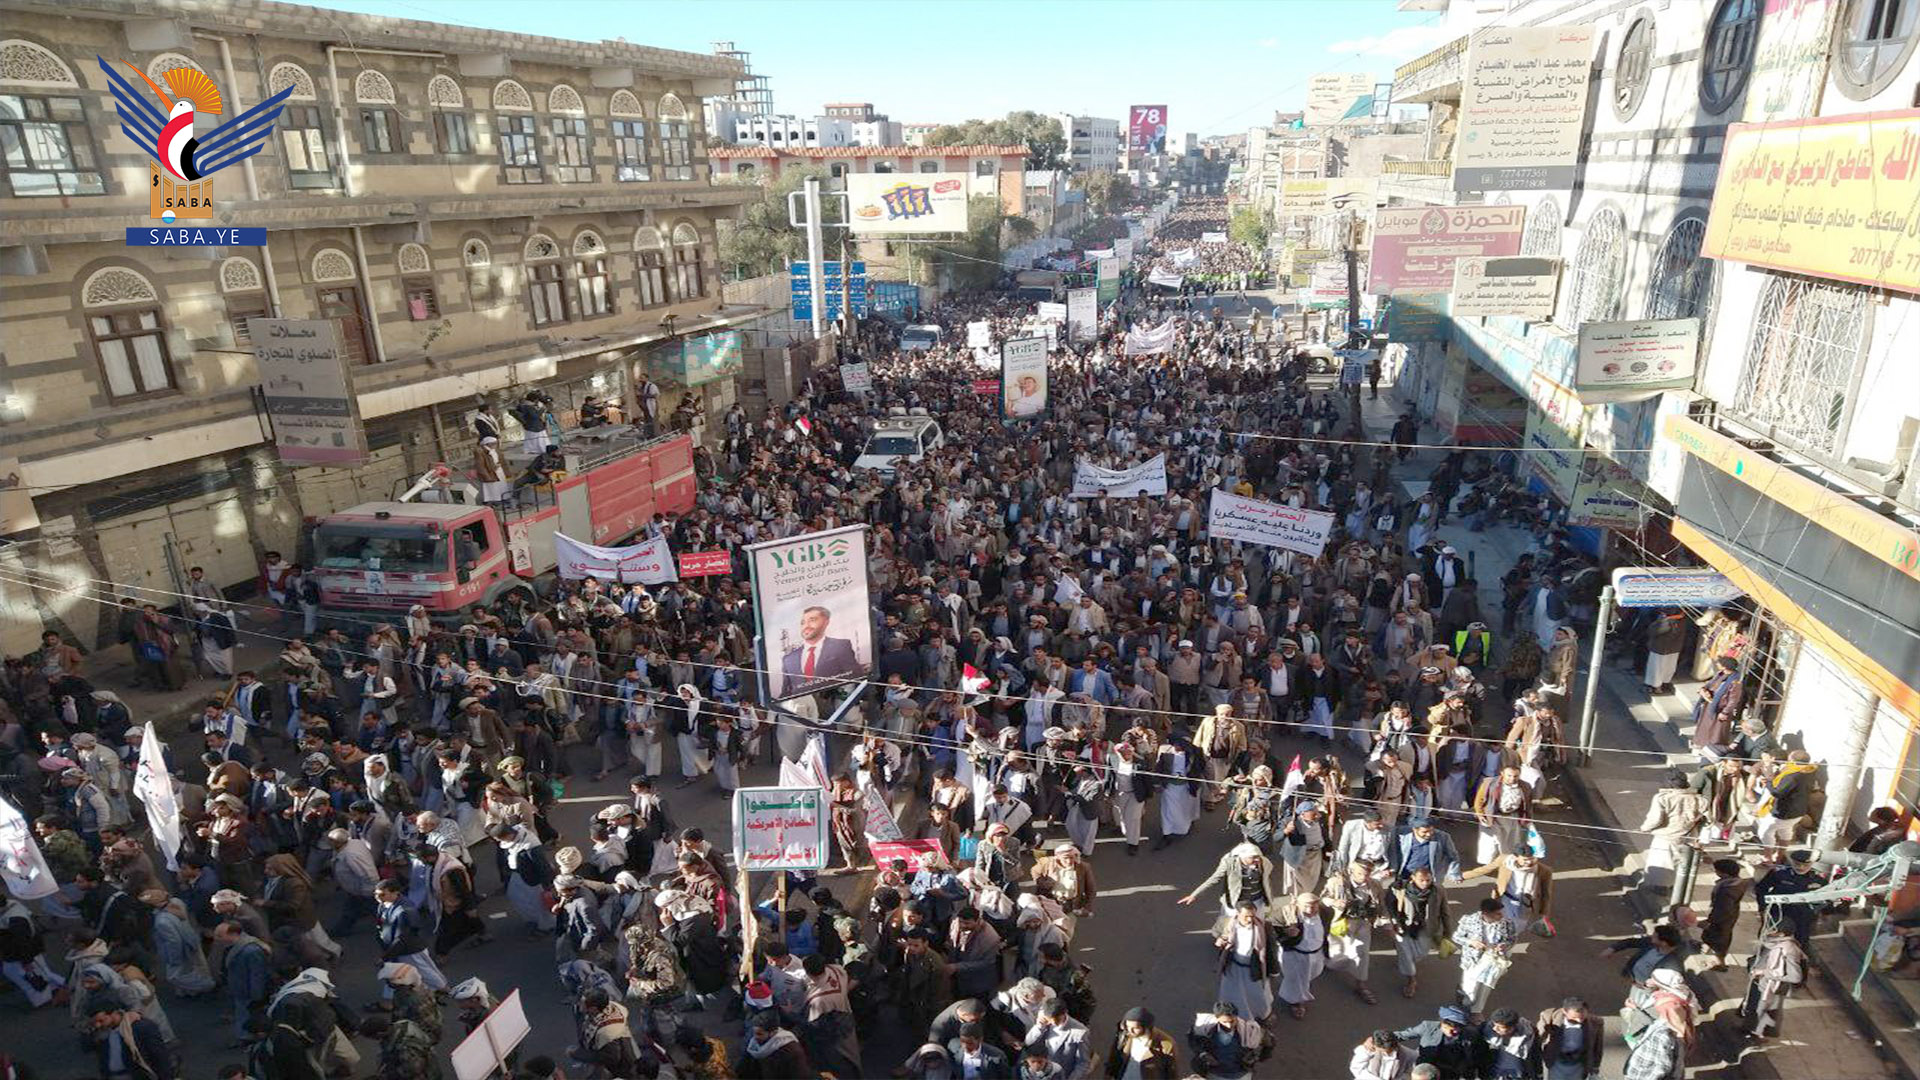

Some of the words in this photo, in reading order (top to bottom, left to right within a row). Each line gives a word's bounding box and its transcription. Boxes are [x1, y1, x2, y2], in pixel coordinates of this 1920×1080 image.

[1473, 76, 1514, 89] النفسية
[1558, 74, 1586, 88] لعلاج
[1523, 89, 1578, 102] والعصبية
[1136, 108, 1160, 125] 78
[1376, 215, 1419, 229] موبايل
[1451, 209, 1521, 231] الحمزة
[270, 324, 317, 338] محلات
[1235, 502, 1268, 514] حرب
[1213, 507, 1260, 527] عسكريا
[1269, 509, 1307, 522] الحصار
[1260, 518, 1289, 532] عليه
[770, 542, 826, 569] YGB
[774, 575, 805, 585] Yemen
[806, 569, 825, 579] Gulf
[827, 566, 850, 576] Bank
[746, 795, 816, 814] قاطعوا
